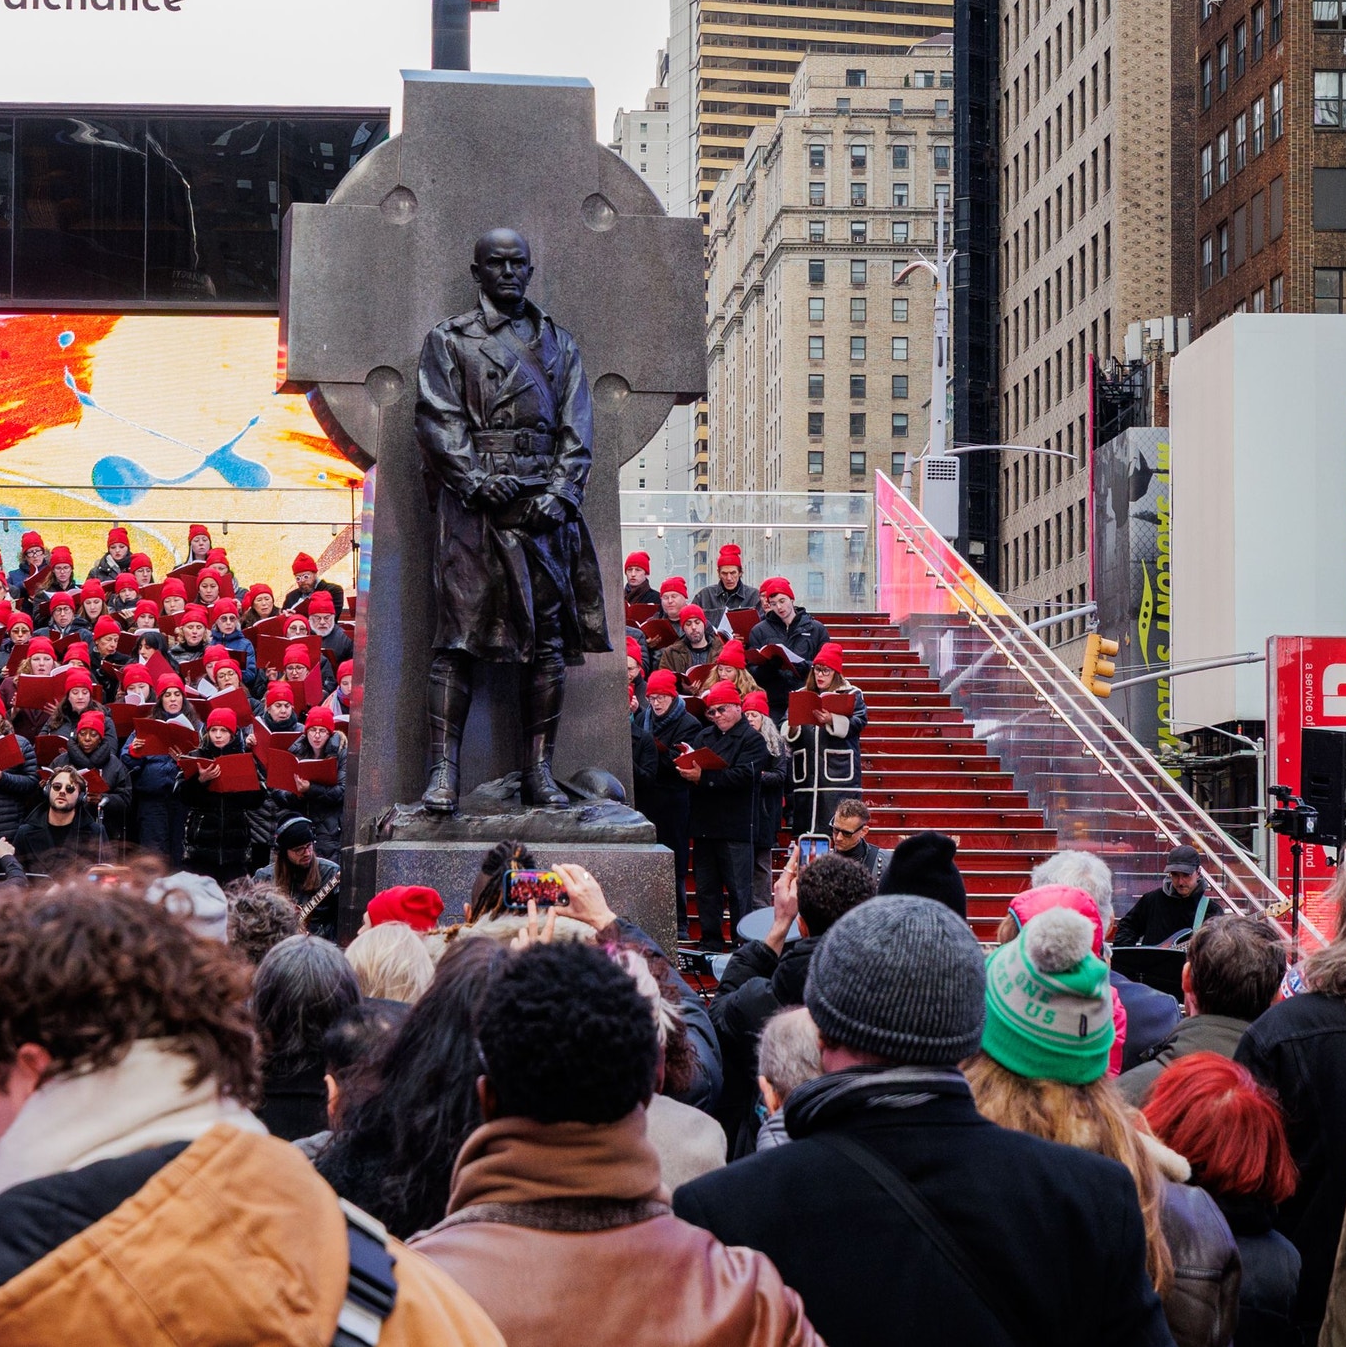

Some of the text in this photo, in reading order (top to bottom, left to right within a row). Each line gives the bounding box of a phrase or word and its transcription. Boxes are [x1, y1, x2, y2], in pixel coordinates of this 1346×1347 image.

[1304, 672, 1314, 712] service
[1304, 714, 1314, 726] of
[1024, 1003, 1057, 1025] US
